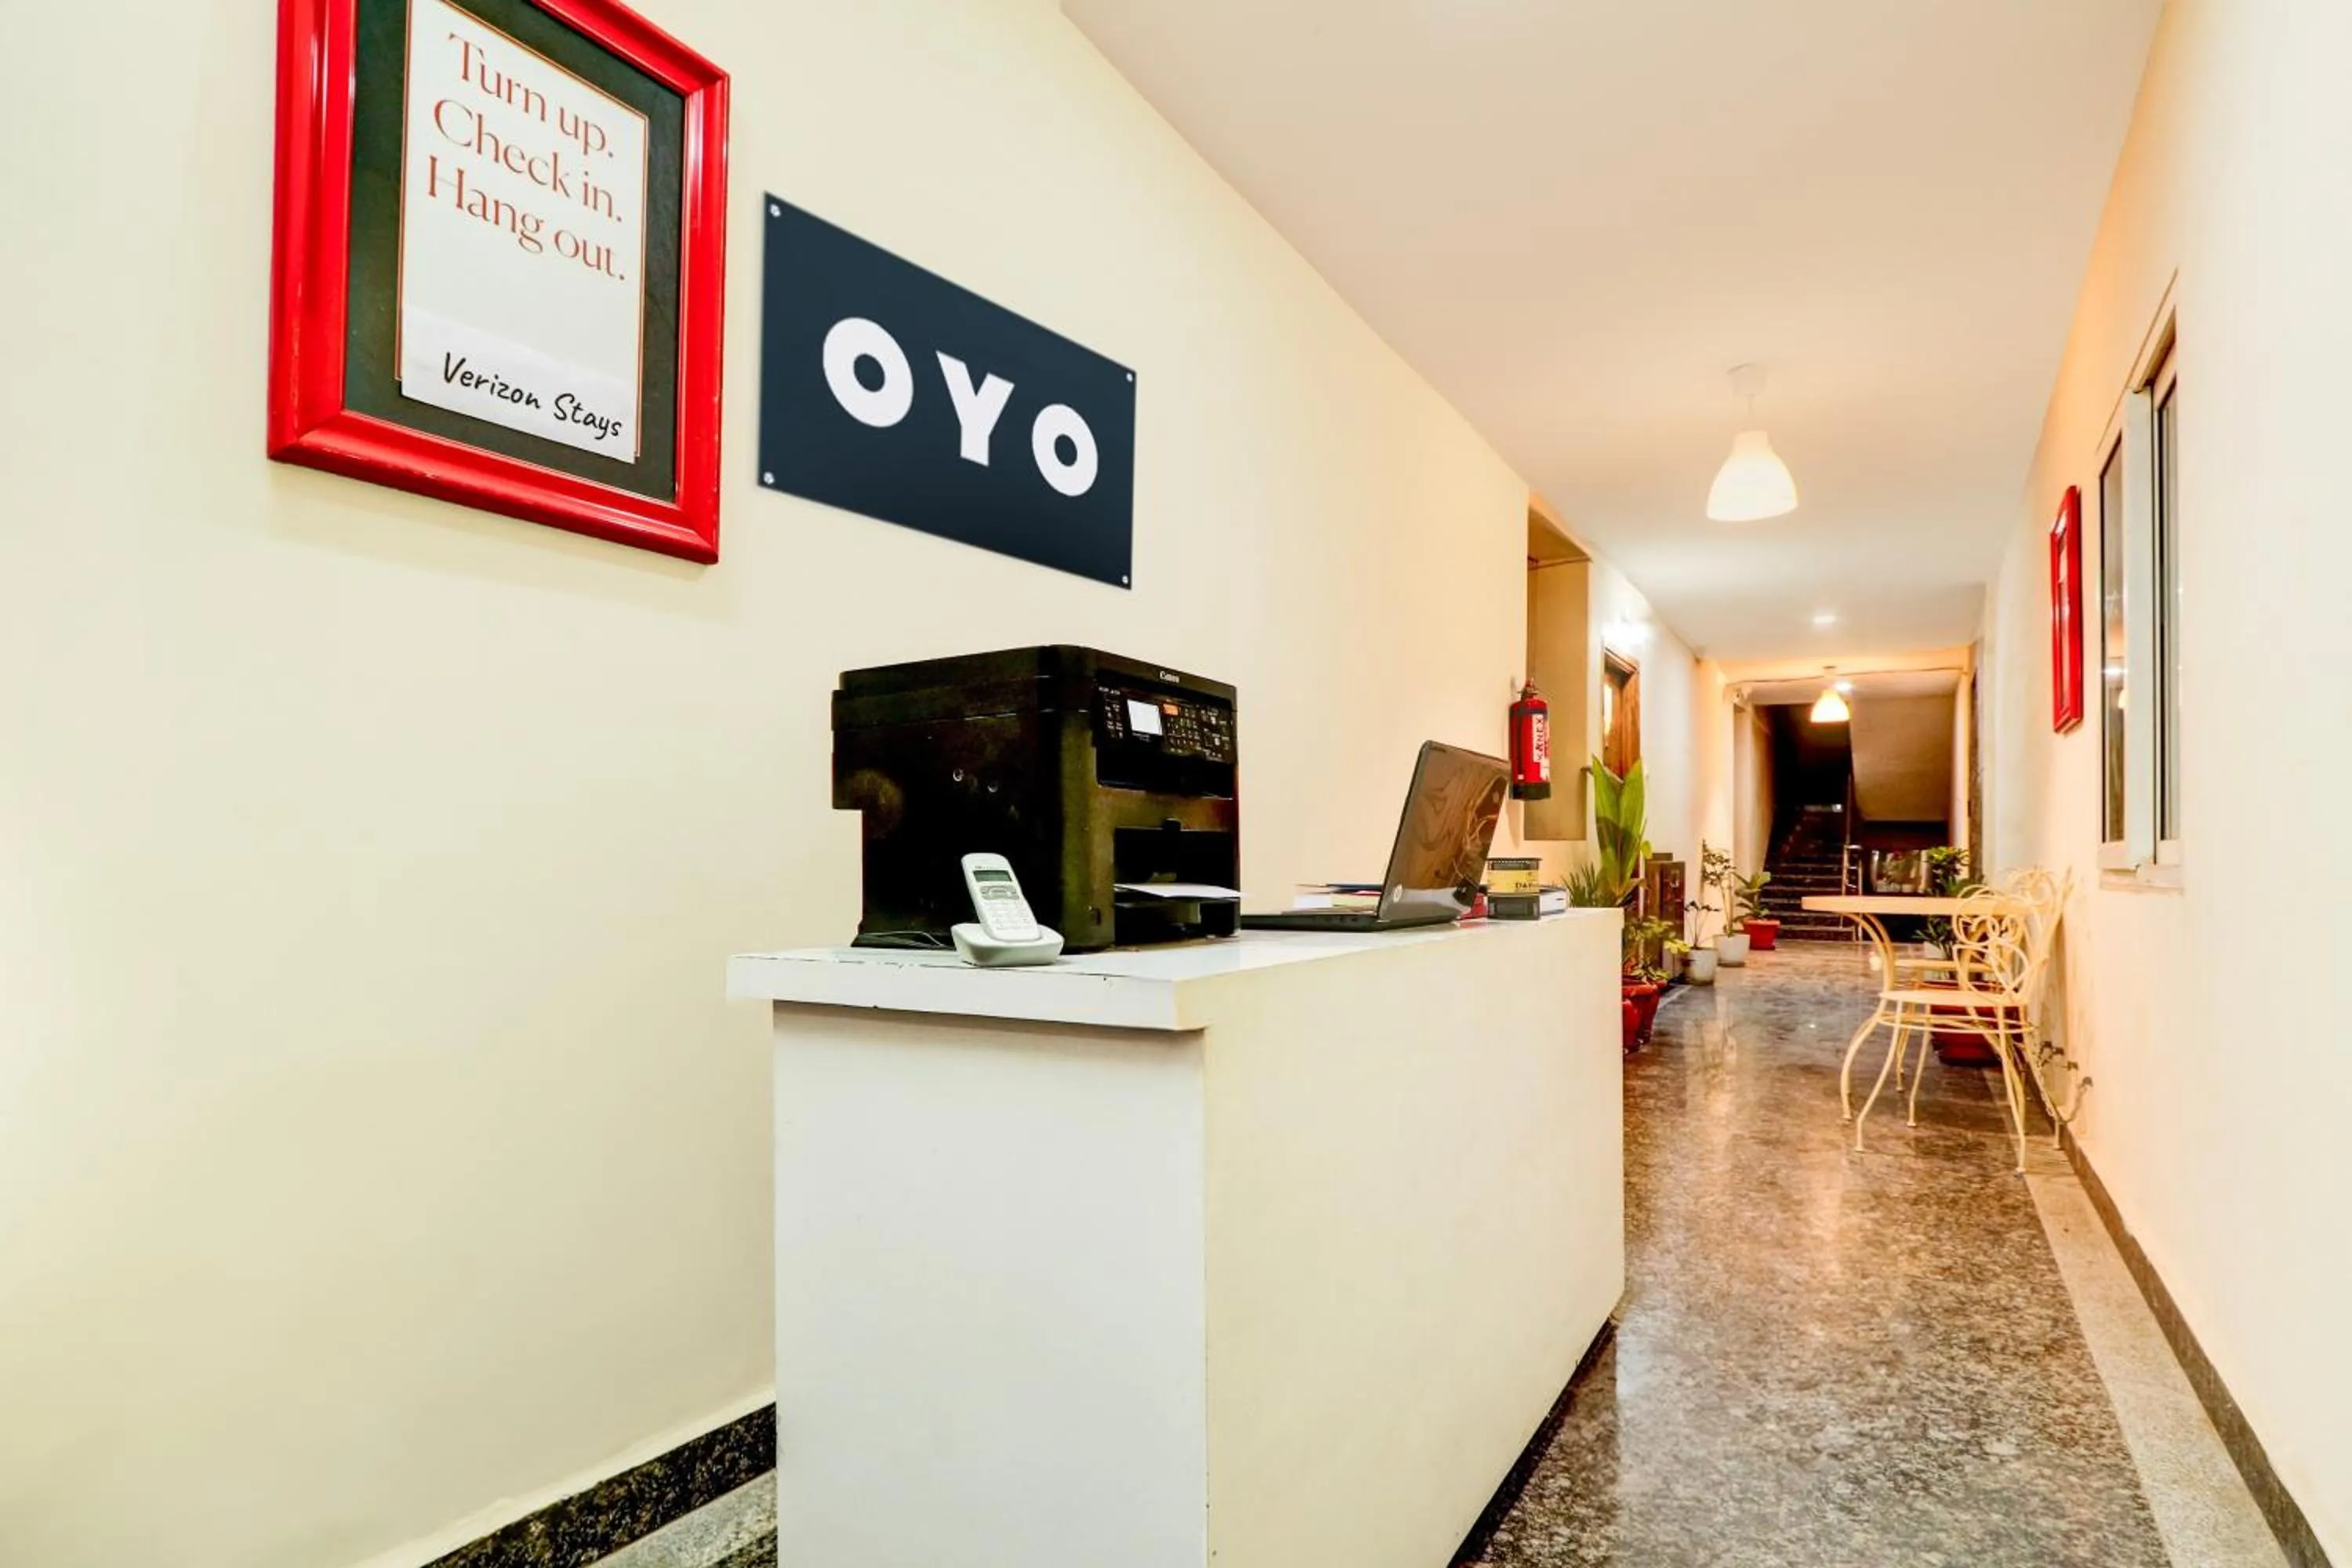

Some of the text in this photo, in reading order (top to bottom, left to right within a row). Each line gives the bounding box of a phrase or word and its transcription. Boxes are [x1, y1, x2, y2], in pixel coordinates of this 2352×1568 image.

[448, 31, 615, 159] Turn up.
[427, 154, 626, 281] Hang out.
[434, 98, 622, 223] Check in.
[443, 351, 623, 441] Verizon Stays
[822, 317, 1098, 497] OYO
